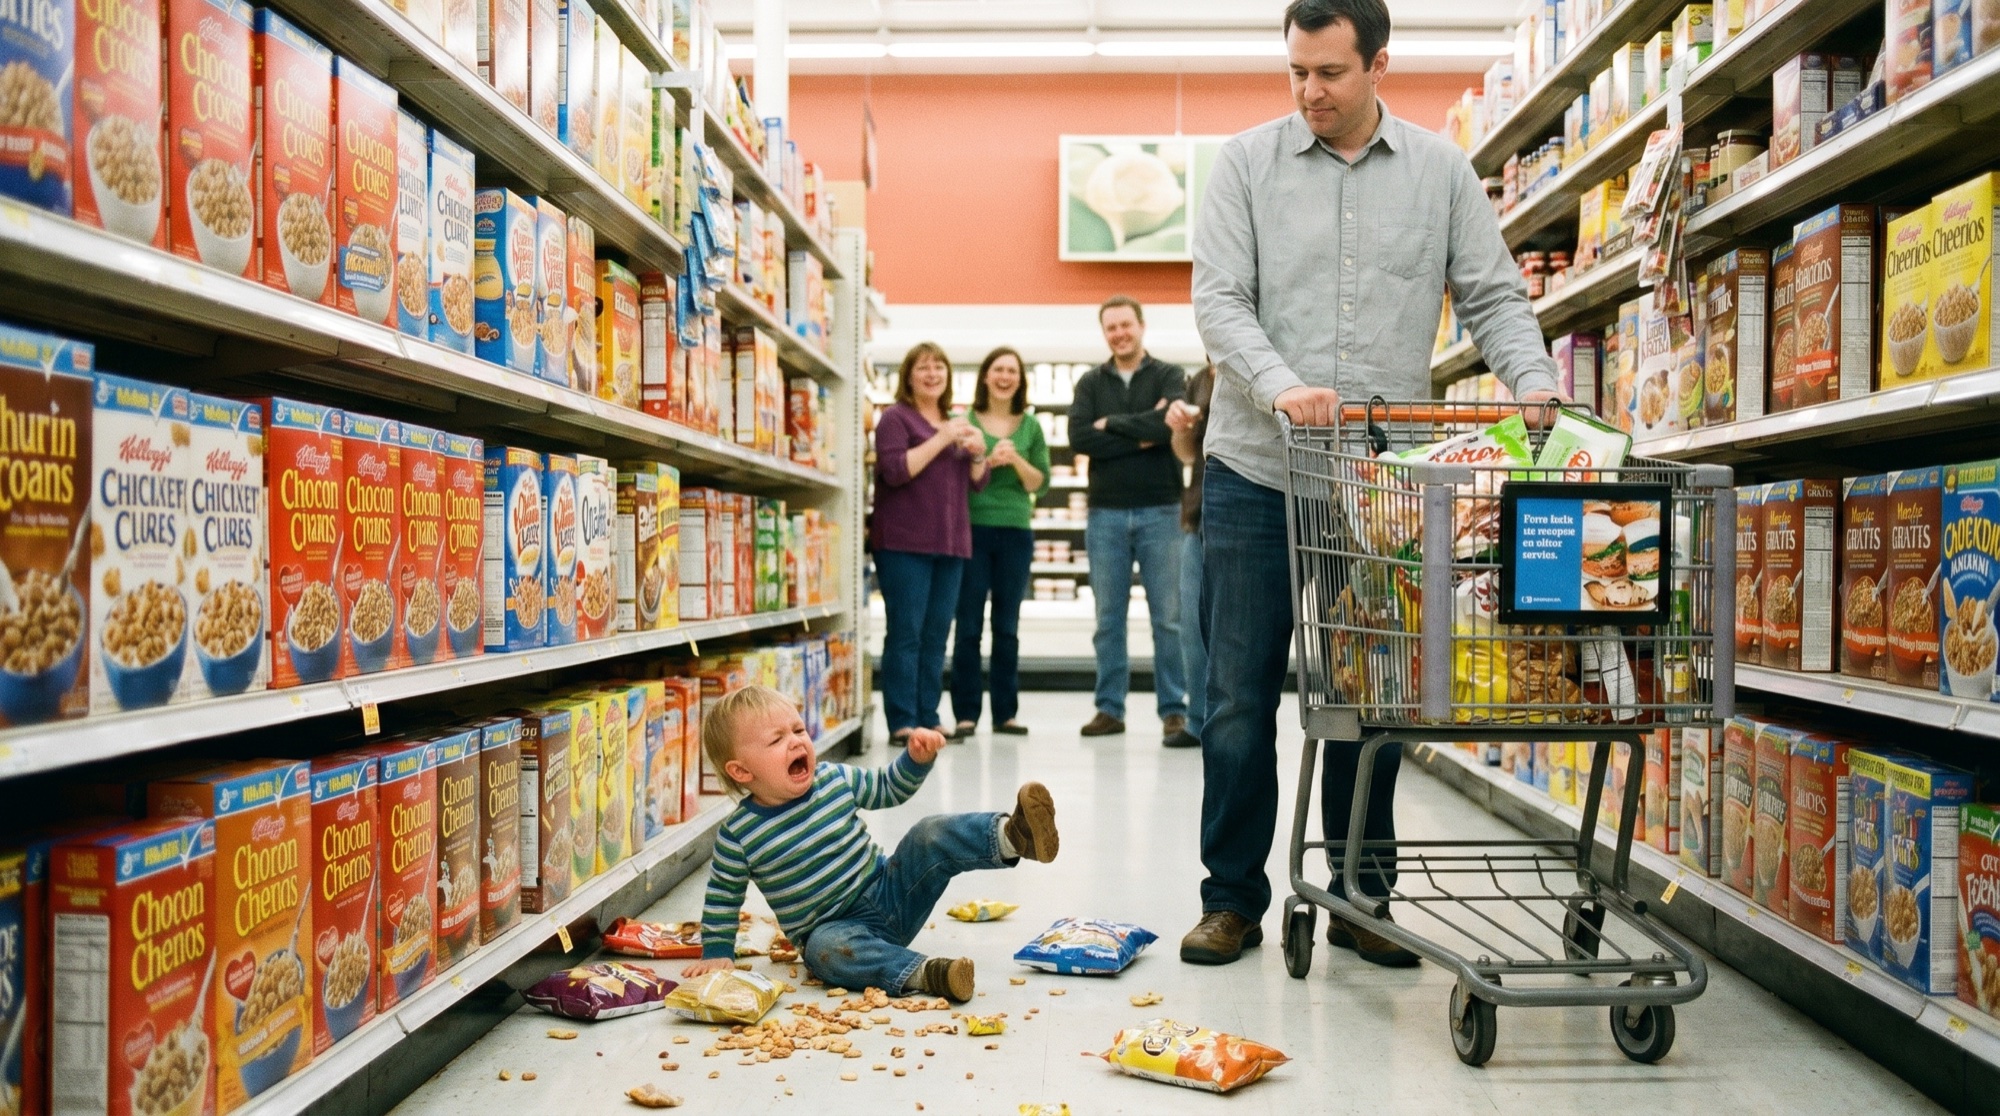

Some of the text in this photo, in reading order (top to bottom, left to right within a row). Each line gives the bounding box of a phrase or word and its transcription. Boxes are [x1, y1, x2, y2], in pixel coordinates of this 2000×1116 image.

[1933, 216, 1985, 259] Cheerios
[1886, 240, 1932, 279] Cheerios
[280, 468, 339, 511] Chocon
[346, 475, 395, 514] Chocon
[403, 482, 441, 518] Chocon
[445, 487, 480, 521] Chocon
[322, 820, 372, 862] Chocon
[131, 881, 206, 942] Chocon
[131, 922, 206, 992] Chenos
